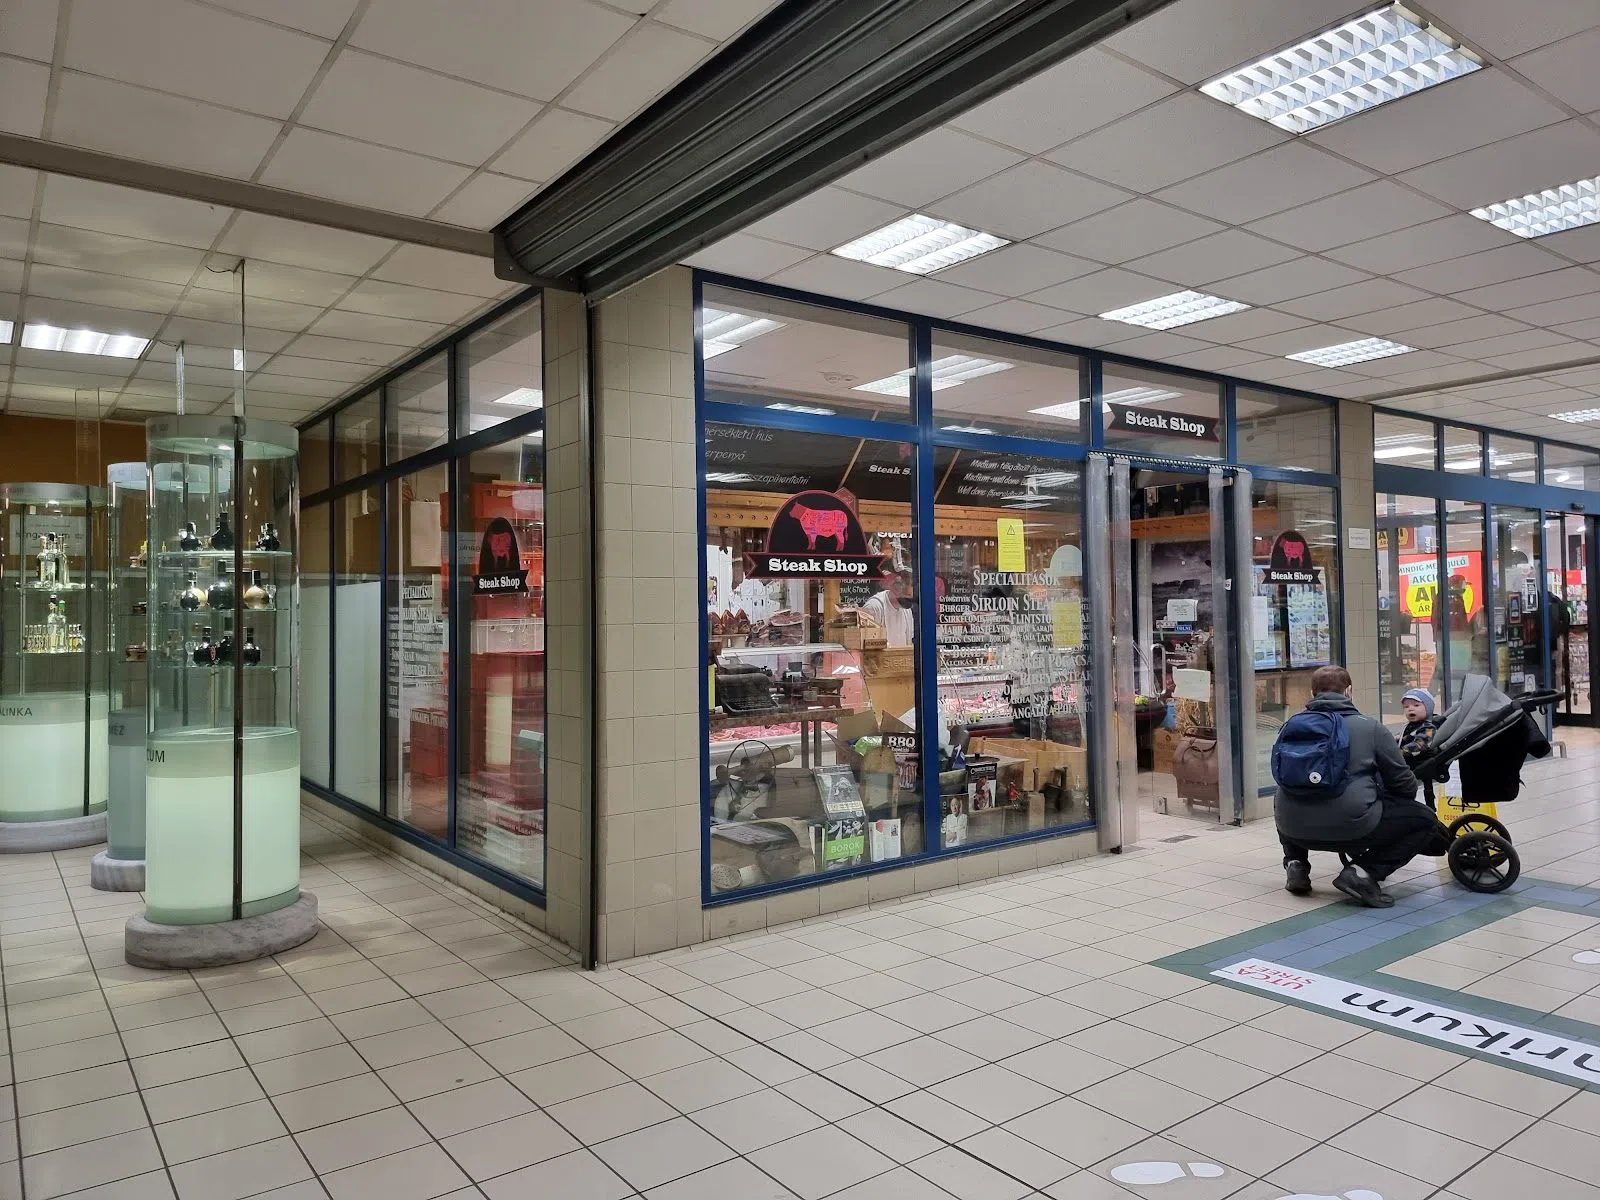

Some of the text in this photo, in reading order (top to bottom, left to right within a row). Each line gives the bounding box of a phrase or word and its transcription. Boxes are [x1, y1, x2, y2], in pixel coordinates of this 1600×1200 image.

[1125, 410, 1205, 437] Steak Shop
[869, 464, 900, 475] Steak
[769, 559, 867, 575] Steak Shop
[479, 576, 520, 589] Steak Shop
[1271, 572, 1313, 582] Steak Shop
[939, 603, 970, 613] BURGER
[971, 593, 1019, 612] SIRLOIN
[888, 736, 916, 748] BBQ
[1238, 968, 1304, 990] UTCA
[1243, 964, 1318, 985] STREET
